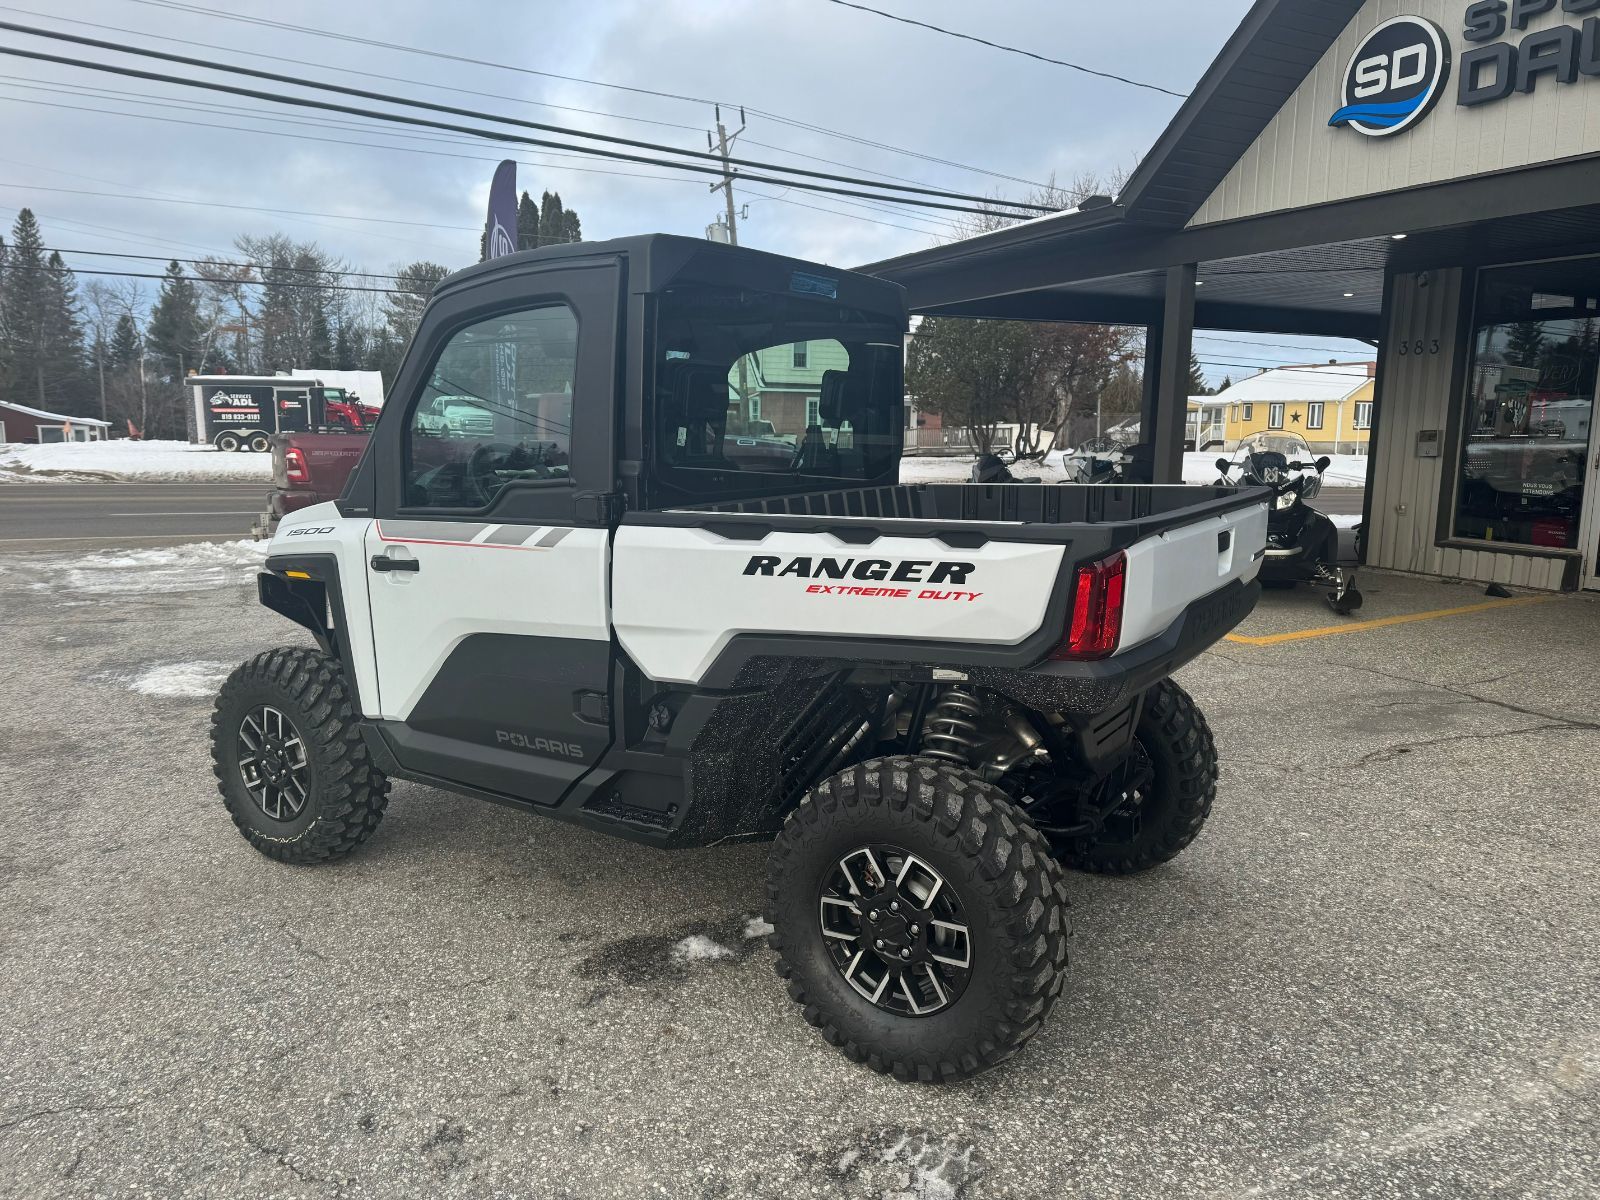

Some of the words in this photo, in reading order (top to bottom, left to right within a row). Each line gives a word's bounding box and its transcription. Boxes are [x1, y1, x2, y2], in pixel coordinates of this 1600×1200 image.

[1354, 42, 1428, 99] SD
[1399, 339, 1440, 356] 383
[286, 526, 335, 537] 1500
[742, 555, 976, 585] RANGER
[806, 584, 911, 599] EXTREME
[918, 588, 983, 602] DUTY
[496, 729, 584, 758] POLARIS
